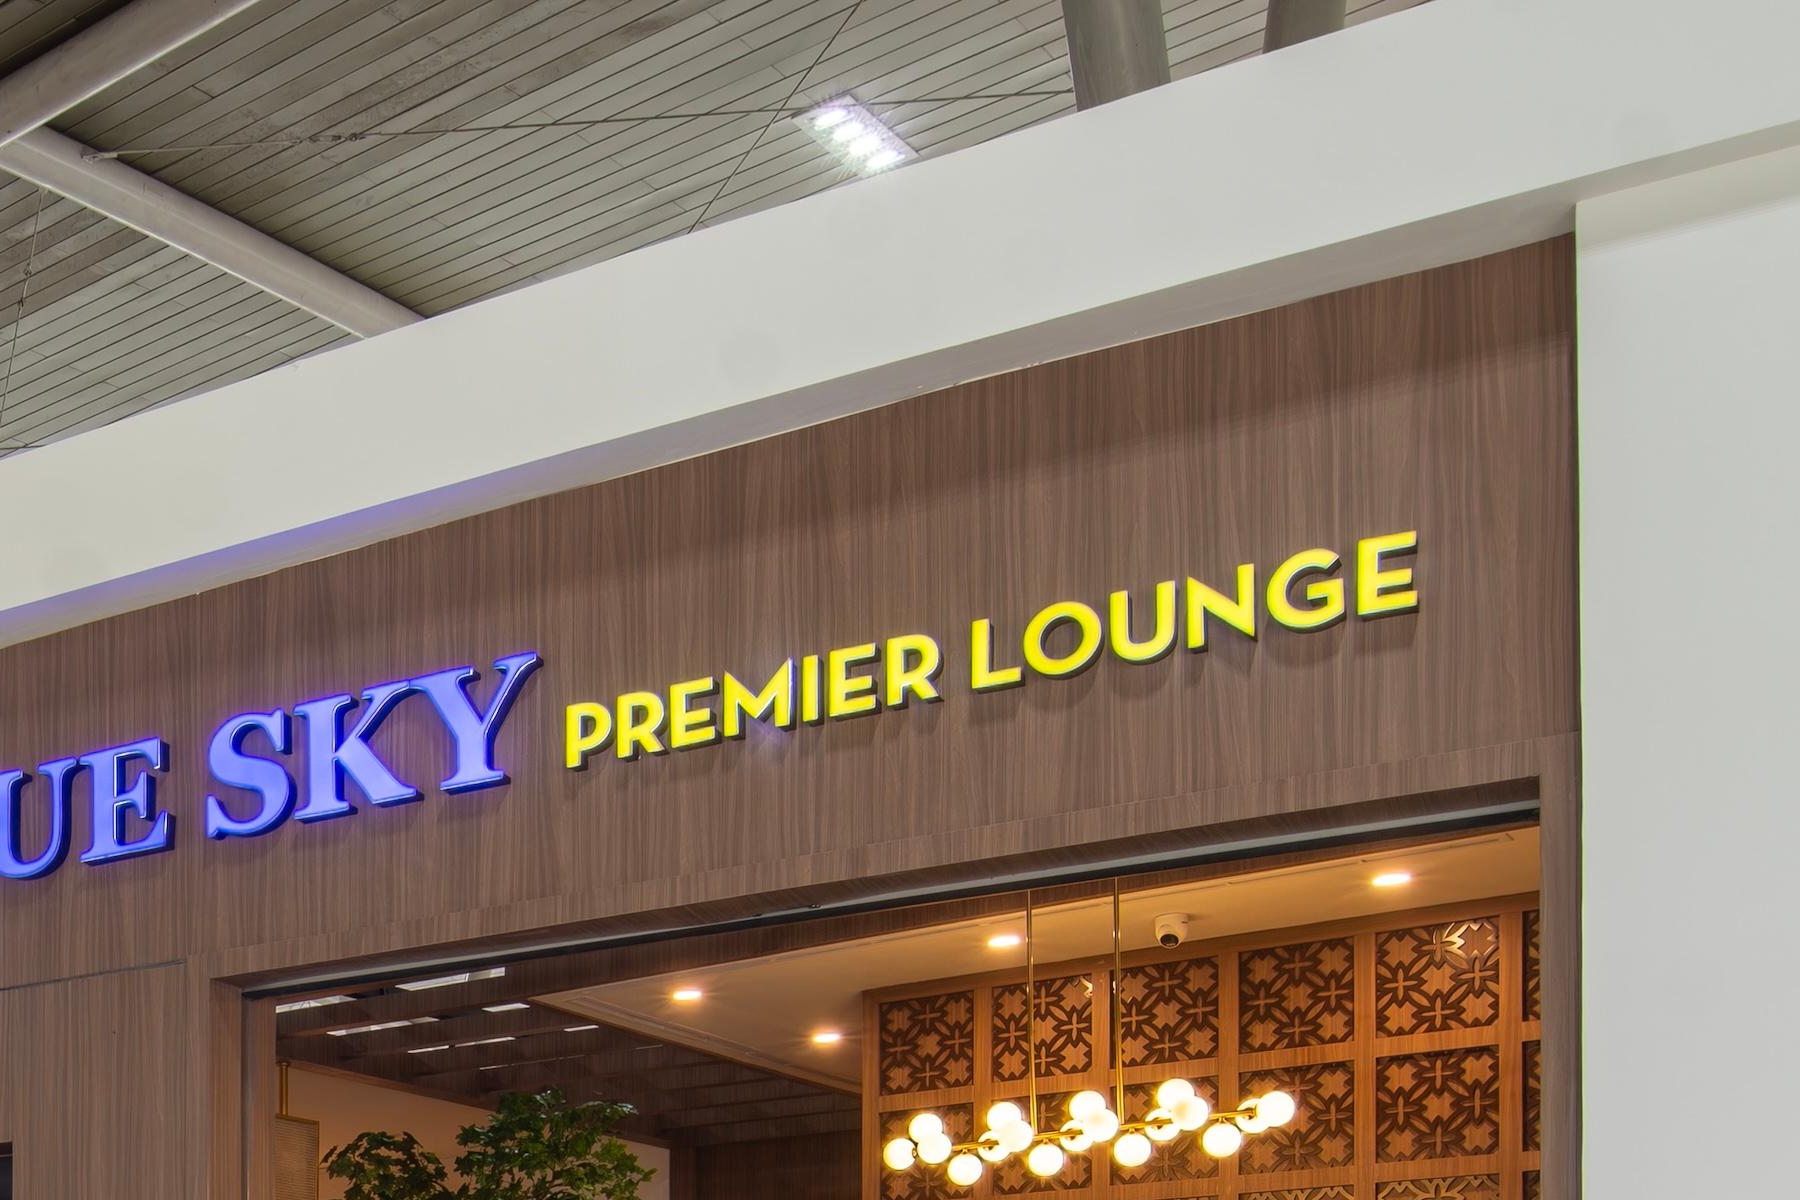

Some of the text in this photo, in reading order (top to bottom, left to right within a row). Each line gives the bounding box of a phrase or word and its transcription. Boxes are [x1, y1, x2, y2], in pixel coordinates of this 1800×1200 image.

[206, 650, 544, 841] SKY
[565, 633, 943, 771] PREMIER
[971, 529, 1420, 694] LOUNGE
